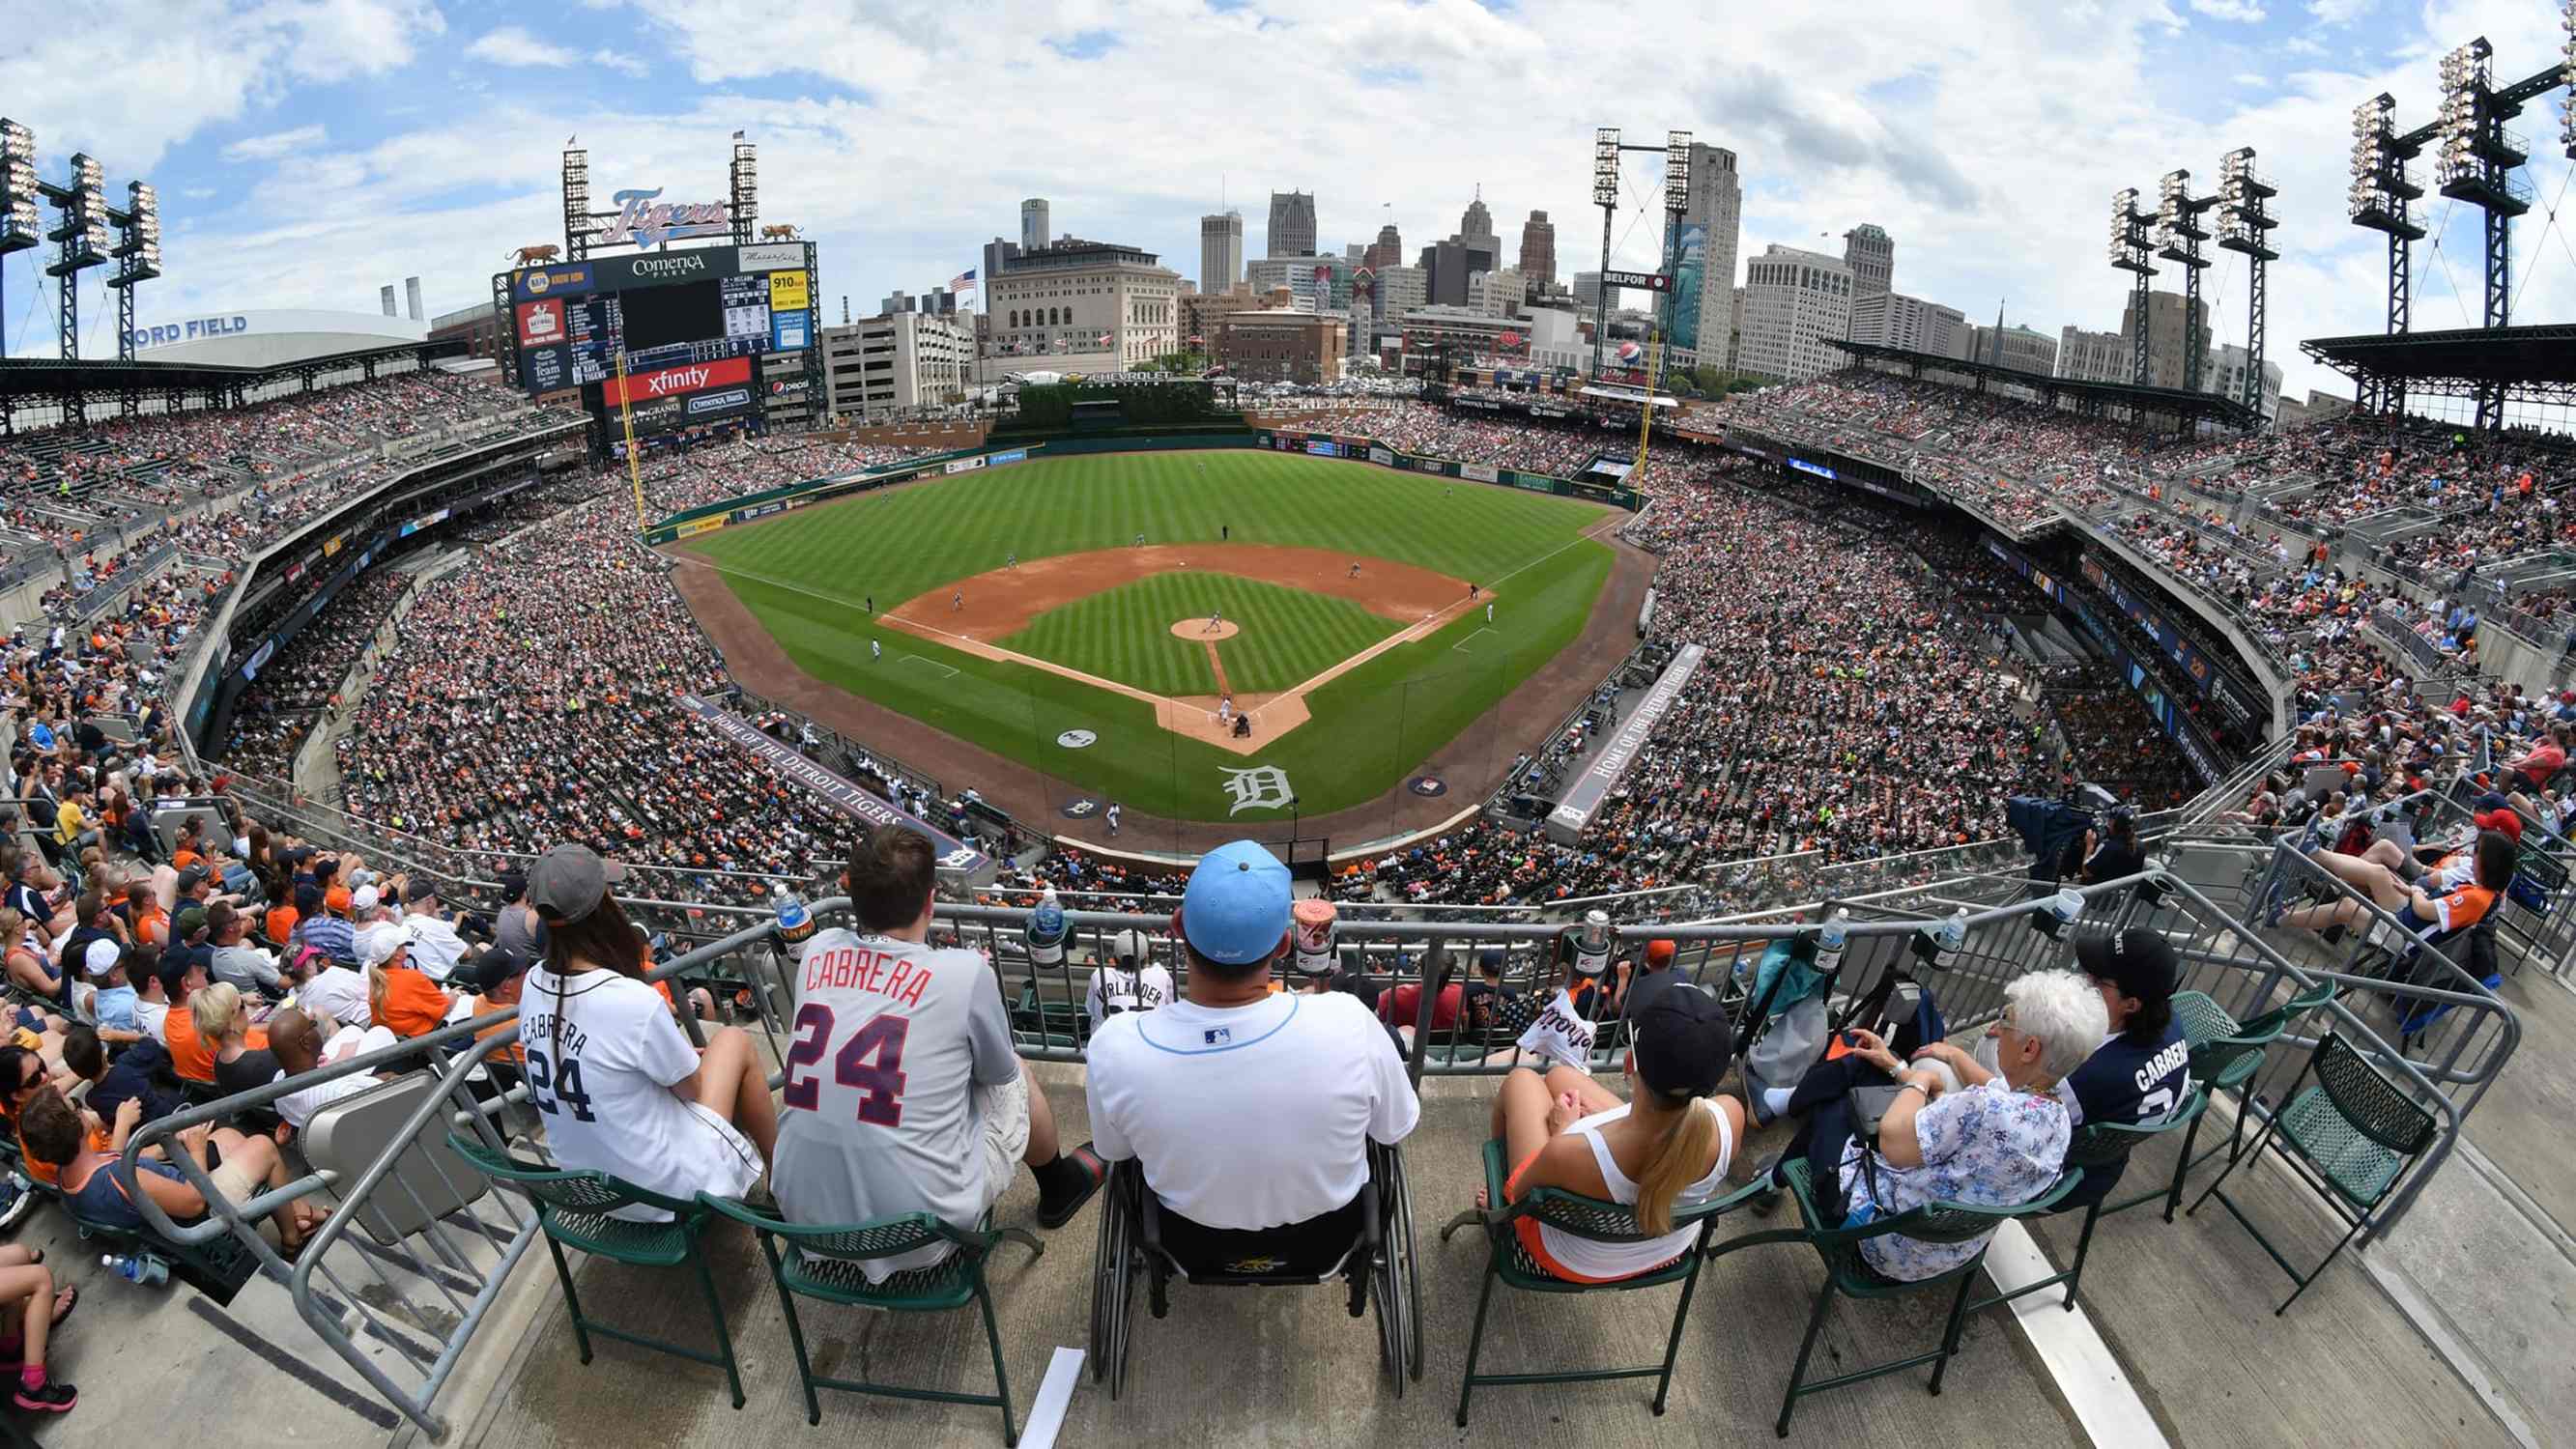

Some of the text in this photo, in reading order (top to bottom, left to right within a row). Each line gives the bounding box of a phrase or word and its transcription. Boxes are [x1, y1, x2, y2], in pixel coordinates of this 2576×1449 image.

[602, 186, 728, 248] Tigers
[632, 254, 704, 276] Comerica
[1604, 272, 1646, 285] BELFOR
[773, 277, 794, 288] 910
[135, 316, 246, 345] ORD FIELD
[648, 366, 709, 395] xfinity
[784, 380, 810, 392] pepsi
[1640, 686, 1671, 717] DETROIT
[1628, 717, 1650, 734] THE
[1619, 734, 1638, 748] OF
[710, 713, 902, 825] HOME OF THE DETROIT TIGERS
[1594, 748, 1626, 779] HOME
[805, 948, 932, 1009] CABRERA
[1097, 981, 1163, 1006] RLANDER
[784, 1003, 909, 1128] 24
[2134, 1039, 2189, 1093] CABRER
[527, 1048, 596, 1122] 24
